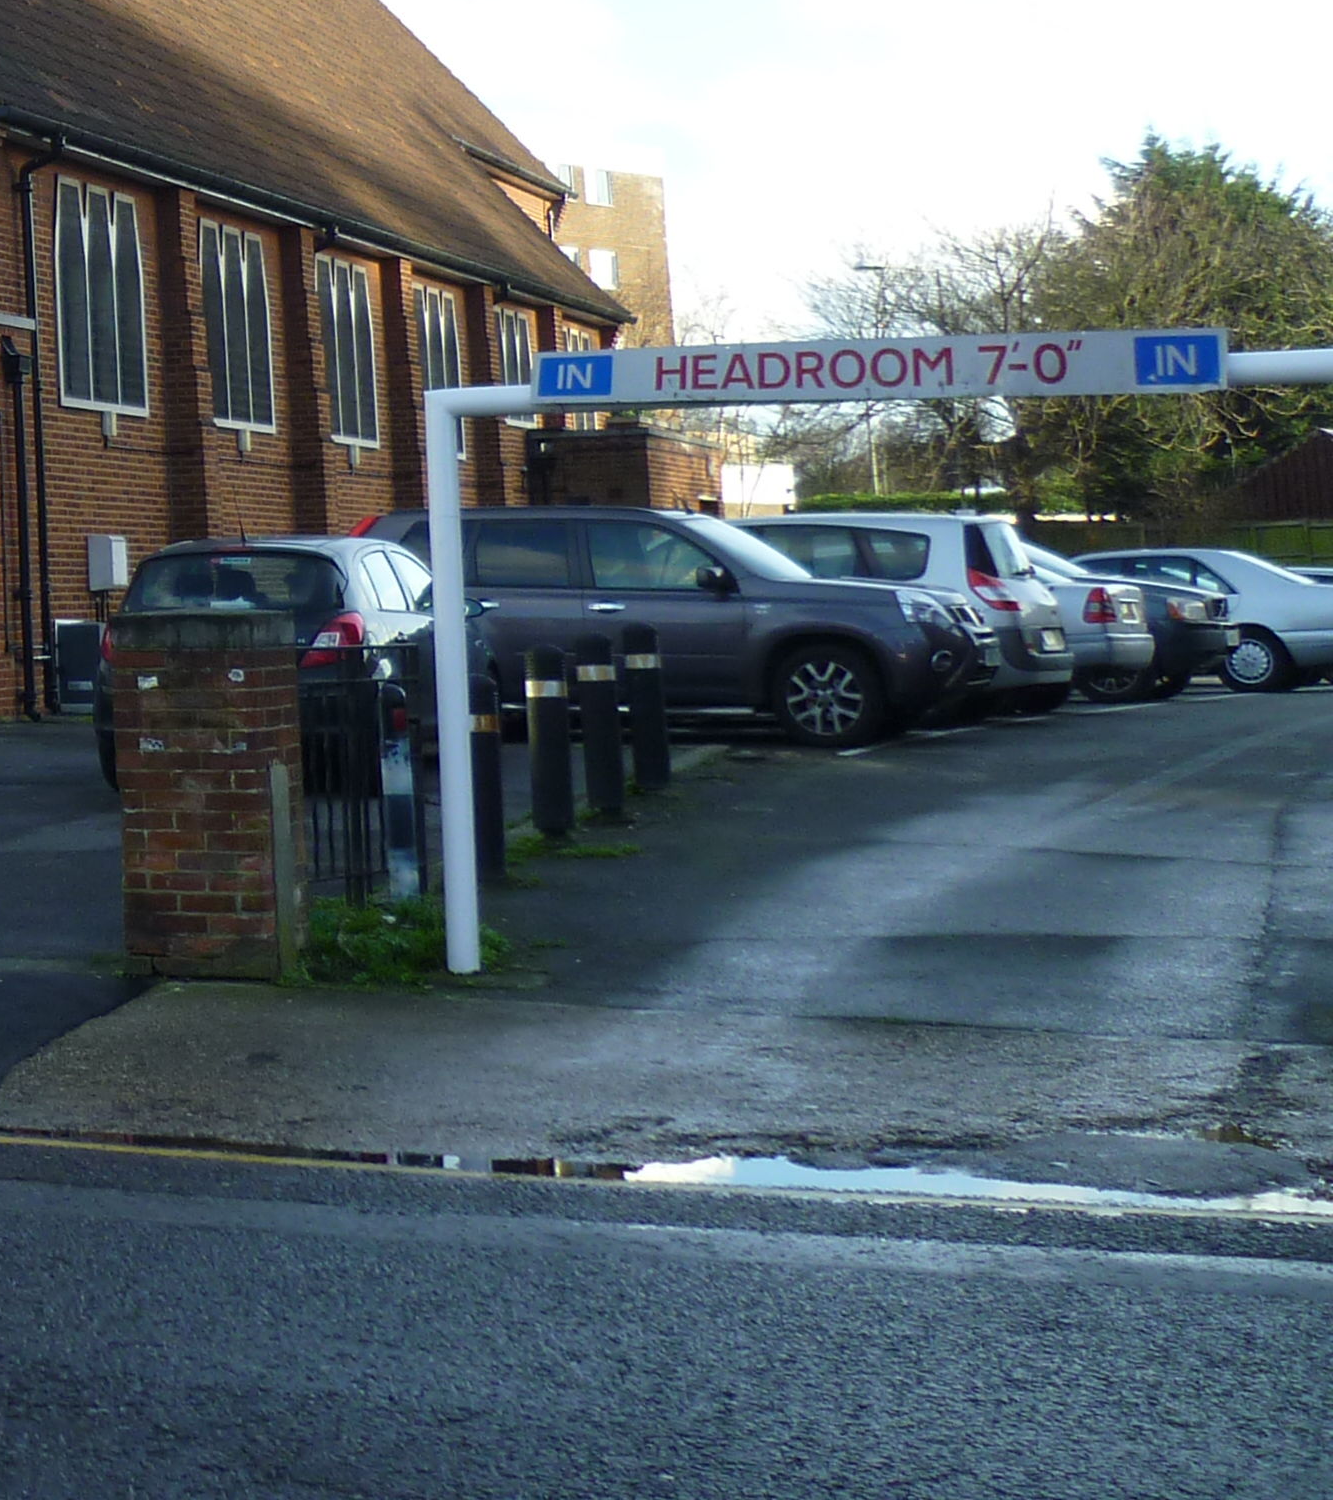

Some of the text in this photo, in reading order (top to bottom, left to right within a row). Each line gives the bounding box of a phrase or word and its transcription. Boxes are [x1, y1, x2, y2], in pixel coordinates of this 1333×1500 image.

[556, 363, 593, 390] IN
[654, 347, 954, 391] HEADROOM
[1156, 344, 1197, 377] IN
